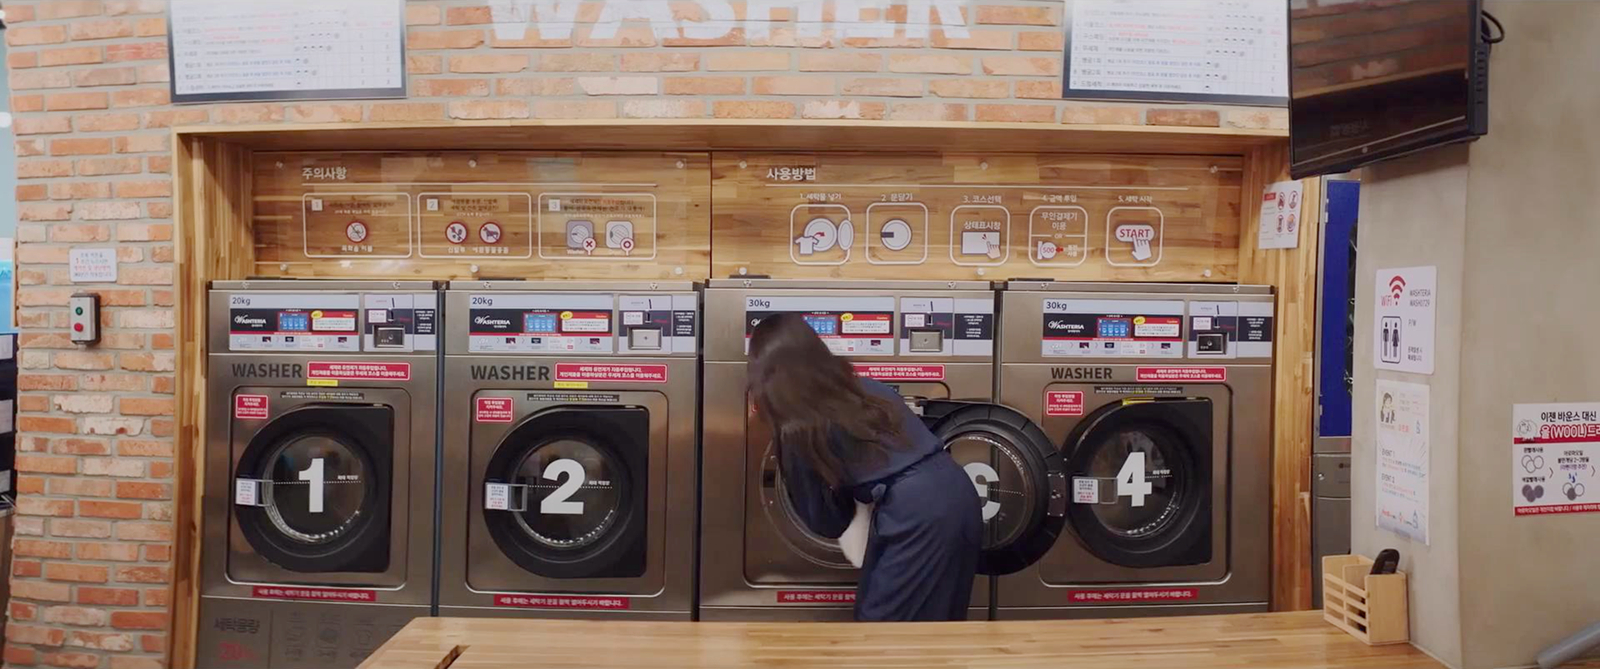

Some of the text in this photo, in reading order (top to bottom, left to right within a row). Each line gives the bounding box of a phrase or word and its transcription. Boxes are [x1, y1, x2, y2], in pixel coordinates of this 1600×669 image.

[302, 167, 347, 180] 주의사항
[766, 168, 816, 180] 사용방법
[890, 193, 912, 202] 문닫기
[972, 195, 1002, 204] 코스선택
[964, 221, 1001, 230] 상태표시창
[1052, 222, 1066, 230] 이용
[1120, 229, 1150, 238] START
[232, 297, 250, 306] 20kg
[472, 297, 492, 306] 20kg
[749, 299, 770, 308] 30kg
[1046, 302, 1067, 311] 30kg
[232, 363, 302, 378] WASHER
[471, 365, 550, 381] WASHER
[1051, 368, 1112, 379] WASHER
[1541, 411, 1596, 422] 이젠 바운스 대신
[1116, 452, 1152, 507] 4
[299, 458, 324, 512] 1
[540, 458, 586, 514] 2
